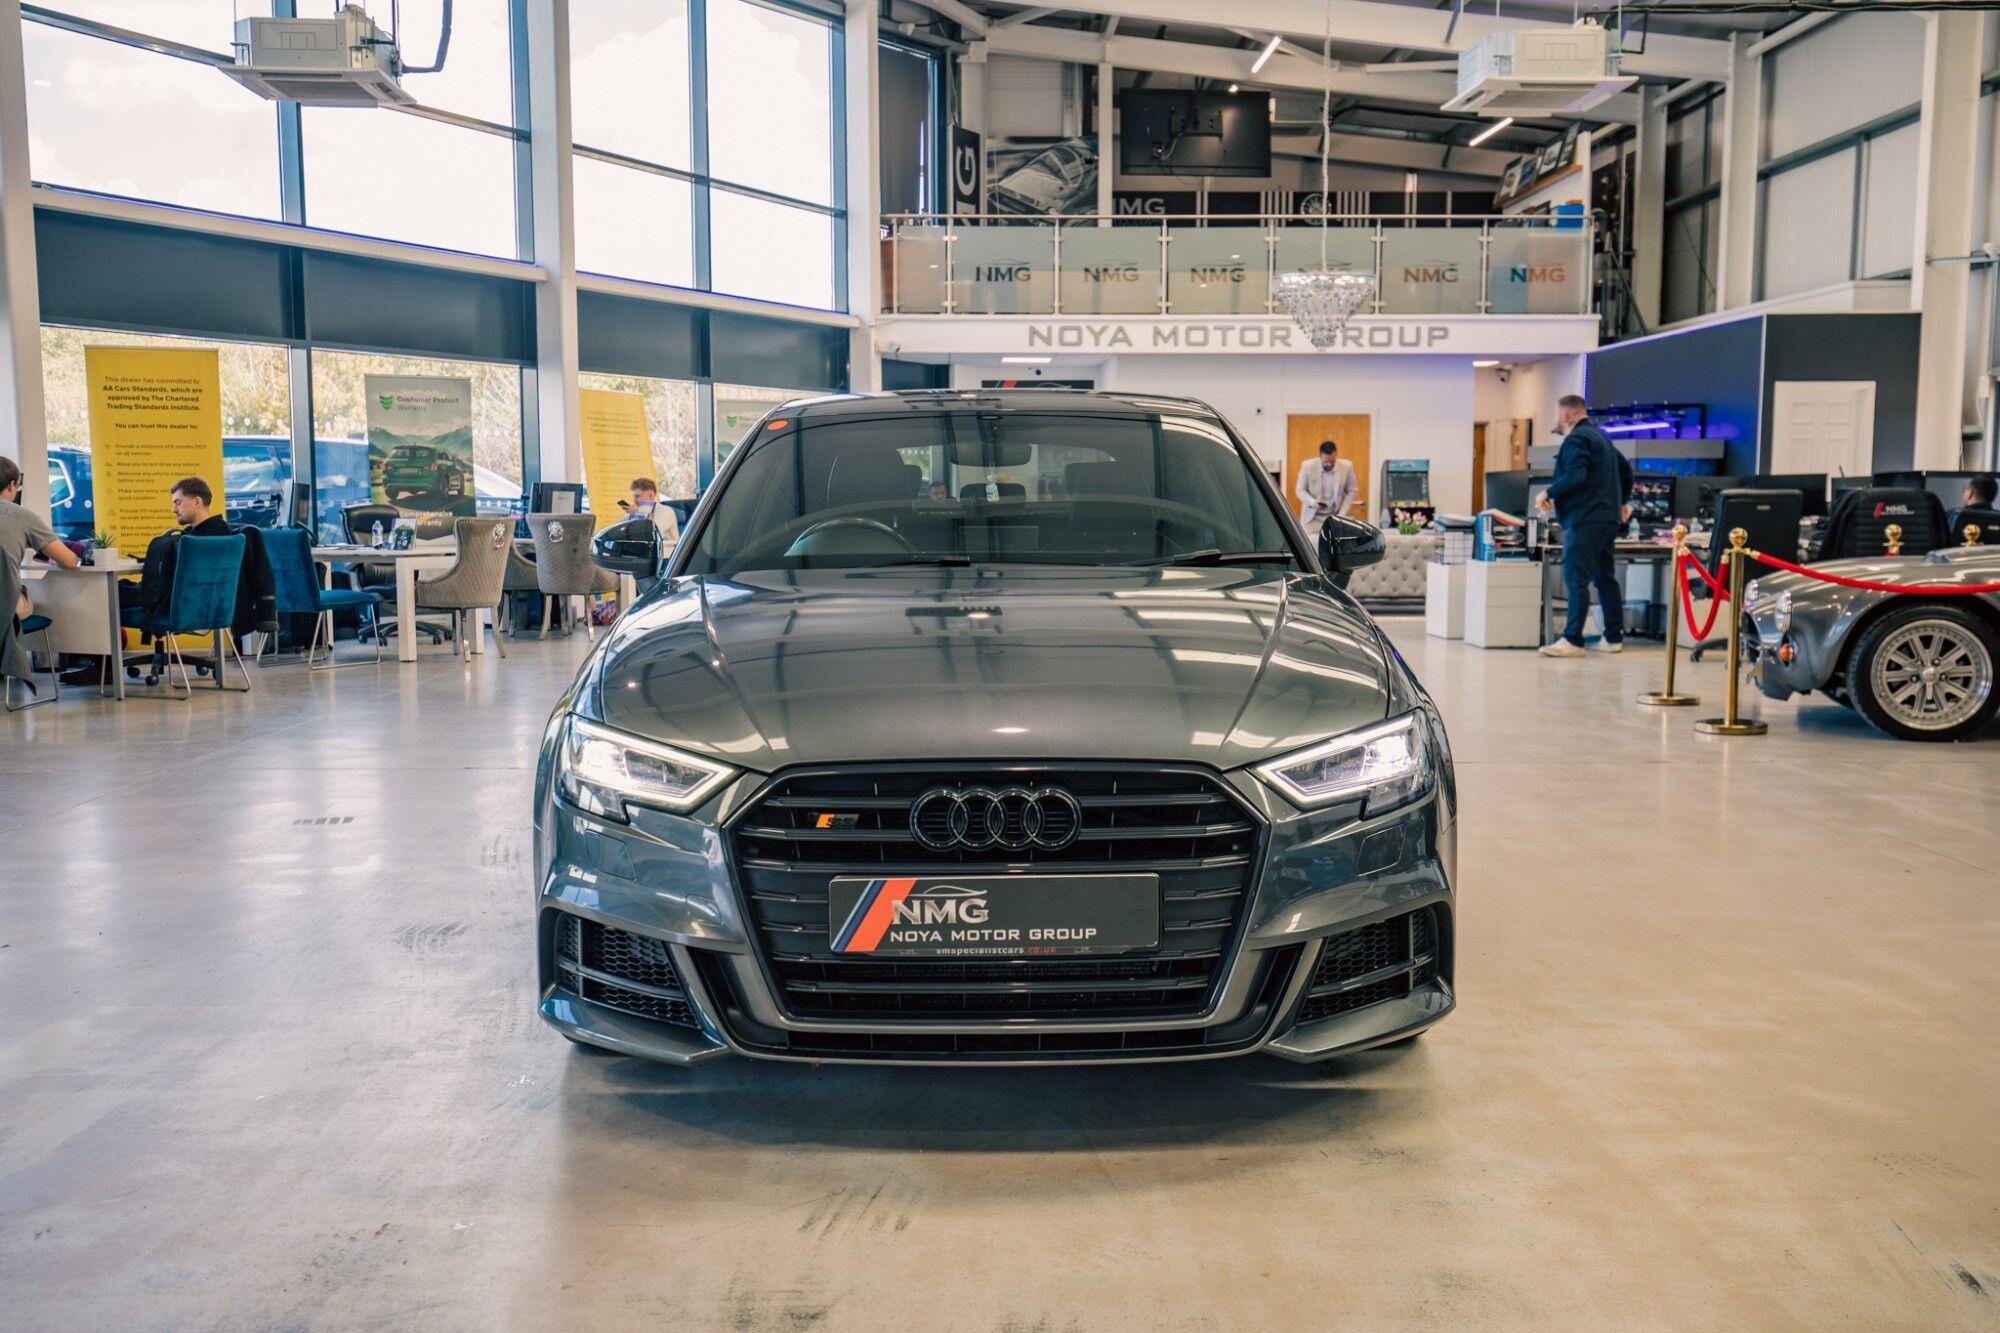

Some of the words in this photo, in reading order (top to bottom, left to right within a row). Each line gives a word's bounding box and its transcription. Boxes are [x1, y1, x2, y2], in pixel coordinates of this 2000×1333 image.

[1112, 197, 1166, 215] MG
[976, 266, 1031, 282] NMG
[1084, 267, 1139, 282] NMG
[1191, 267, 1245, 282] NMG
[1511, 267, 1565, 282] NMG
[1029, 325, 1133, 347] NOYA
[1153, 325, 1292, 347] MOTOR
[1340, 326, 1449, 347] ROUP
[400, 511, 453, 519] Comprehensive
[892, 899, 989, 924] NMG
[890, 930, 943, 942] NOYA
[951, 929, 1021, 941] MOTOR
[1029, 928, 1097, 940] GROUP
